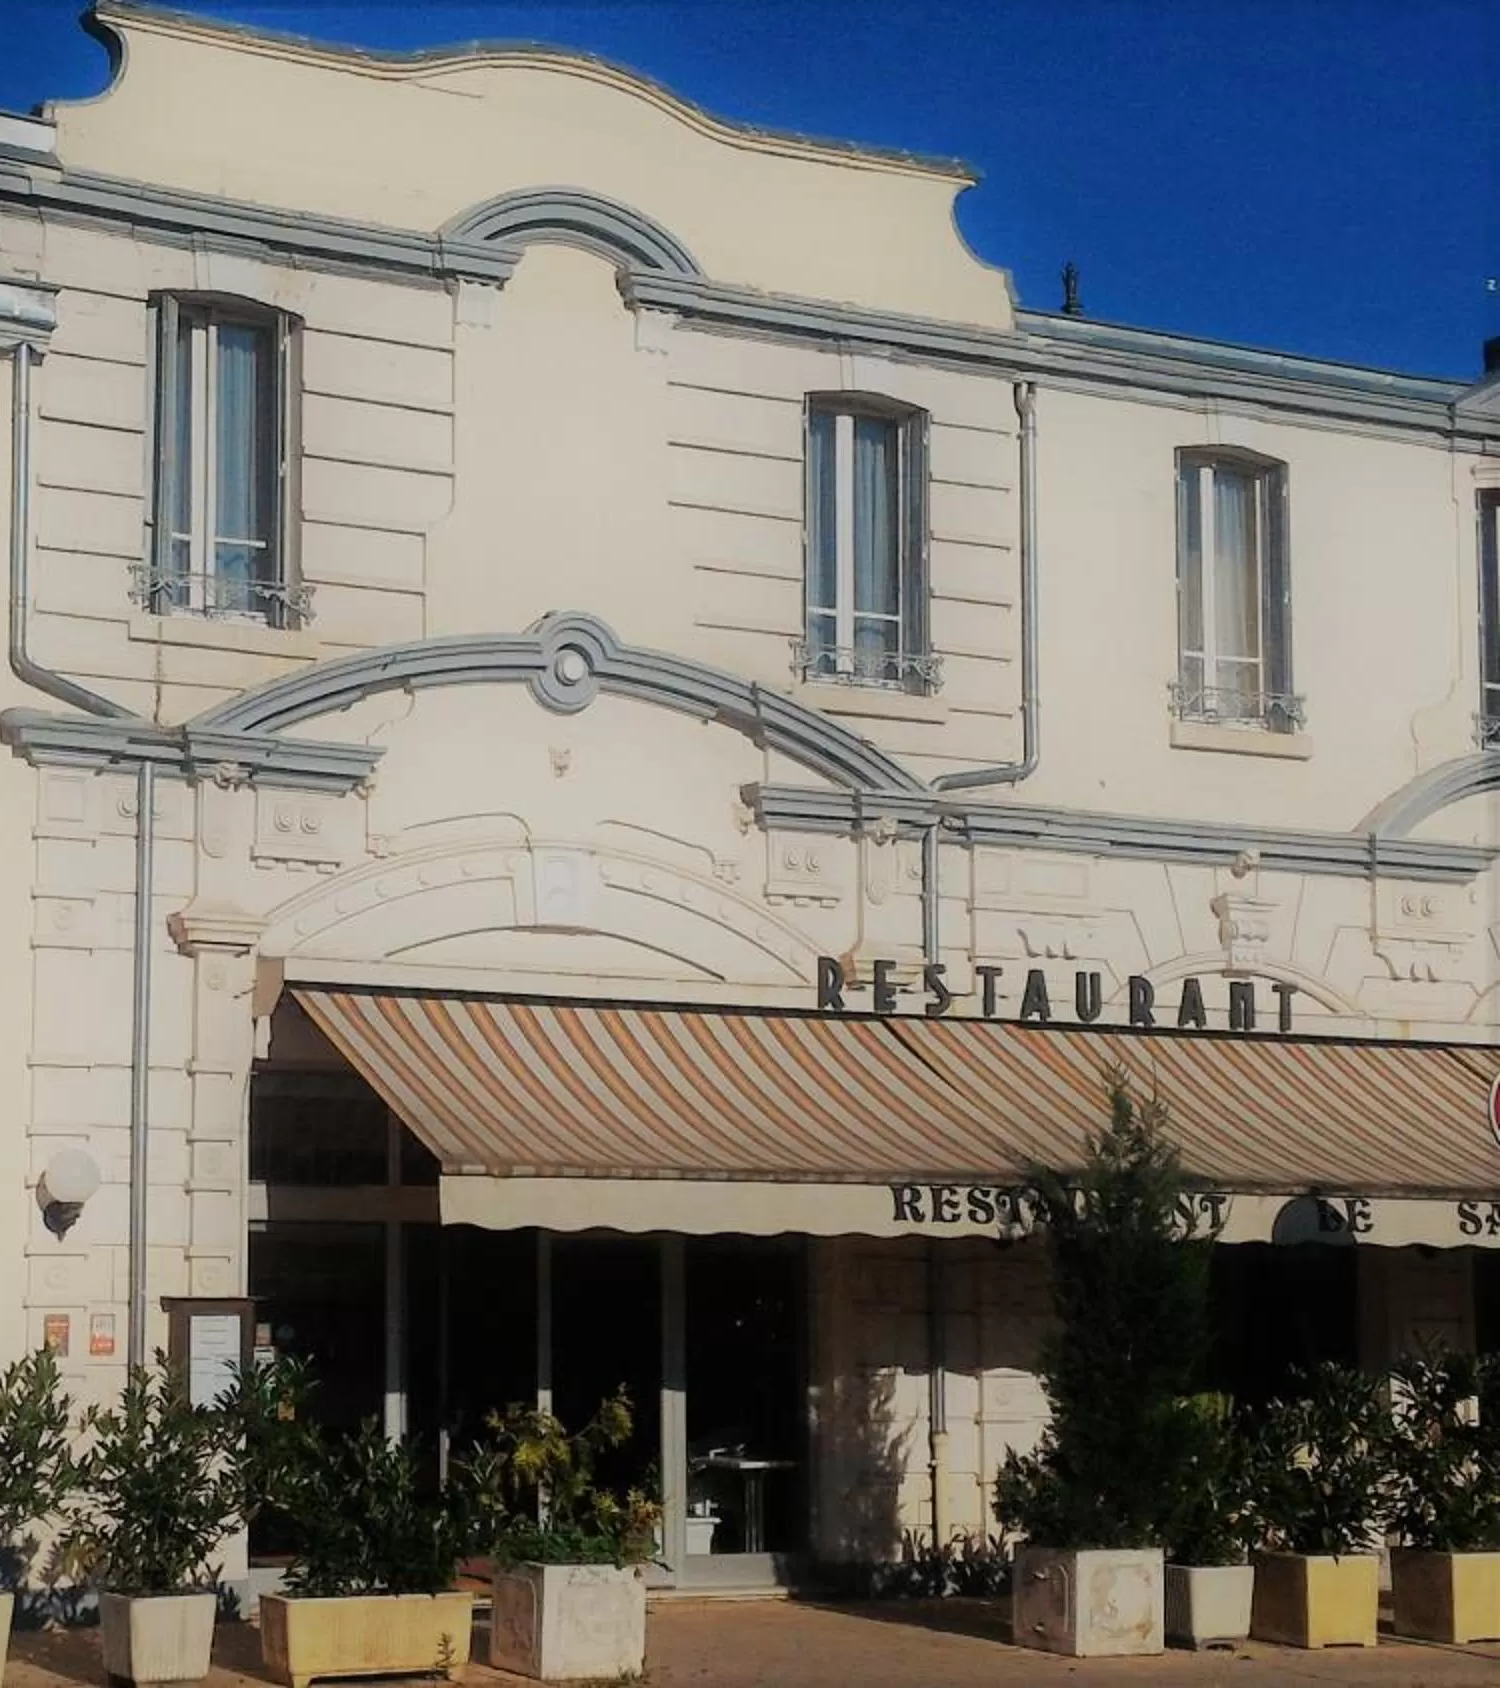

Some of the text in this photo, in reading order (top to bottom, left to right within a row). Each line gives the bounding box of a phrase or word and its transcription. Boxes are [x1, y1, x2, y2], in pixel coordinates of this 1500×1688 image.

[817, 956, 1299, 1032] RESTAURANT
[891, 1184, 1228, 1229] RESTNT
[1316, 1198, 1374, 1233] DE
